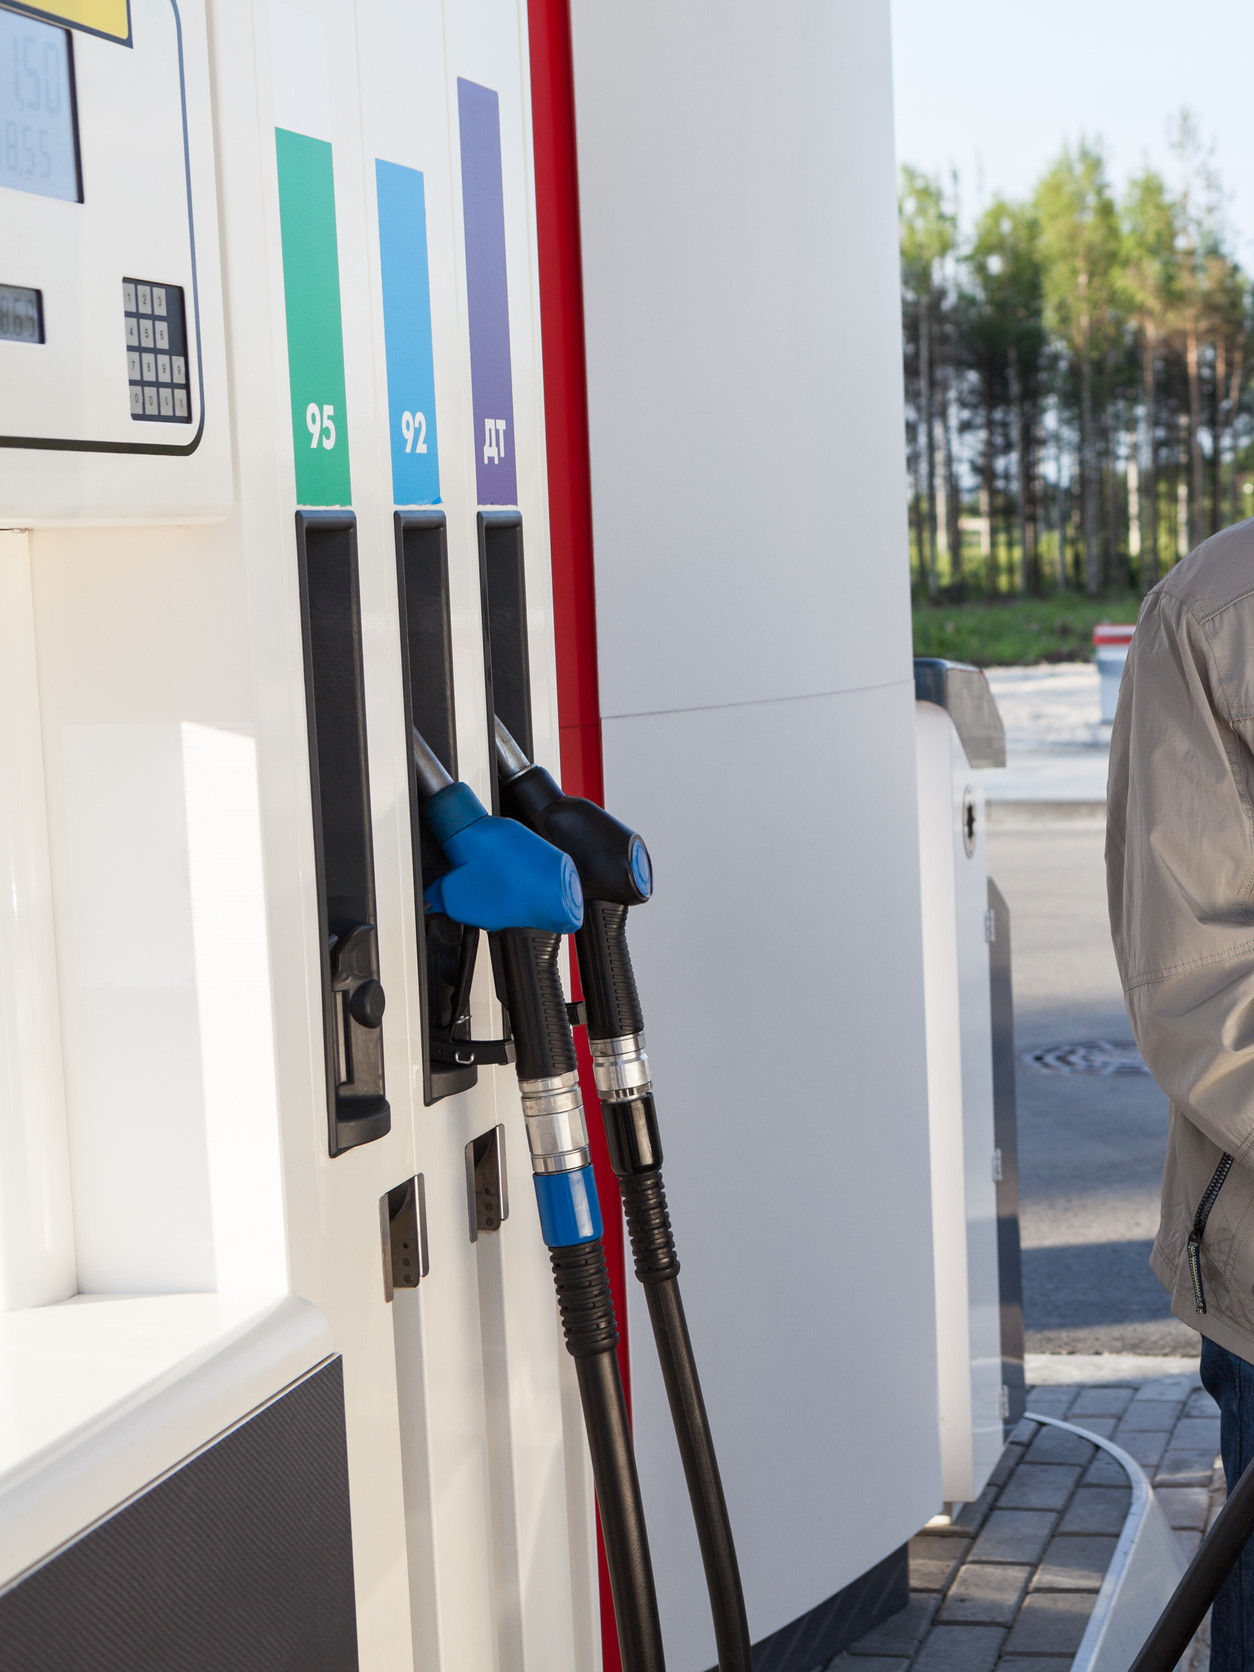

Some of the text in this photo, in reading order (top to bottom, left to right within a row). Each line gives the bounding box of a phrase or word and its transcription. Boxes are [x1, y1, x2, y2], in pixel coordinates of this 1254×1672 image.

[306, 402, 336, 450] 95
[401, 410, 428, 454] 92
[483, 418, 506, 465] ДТ
